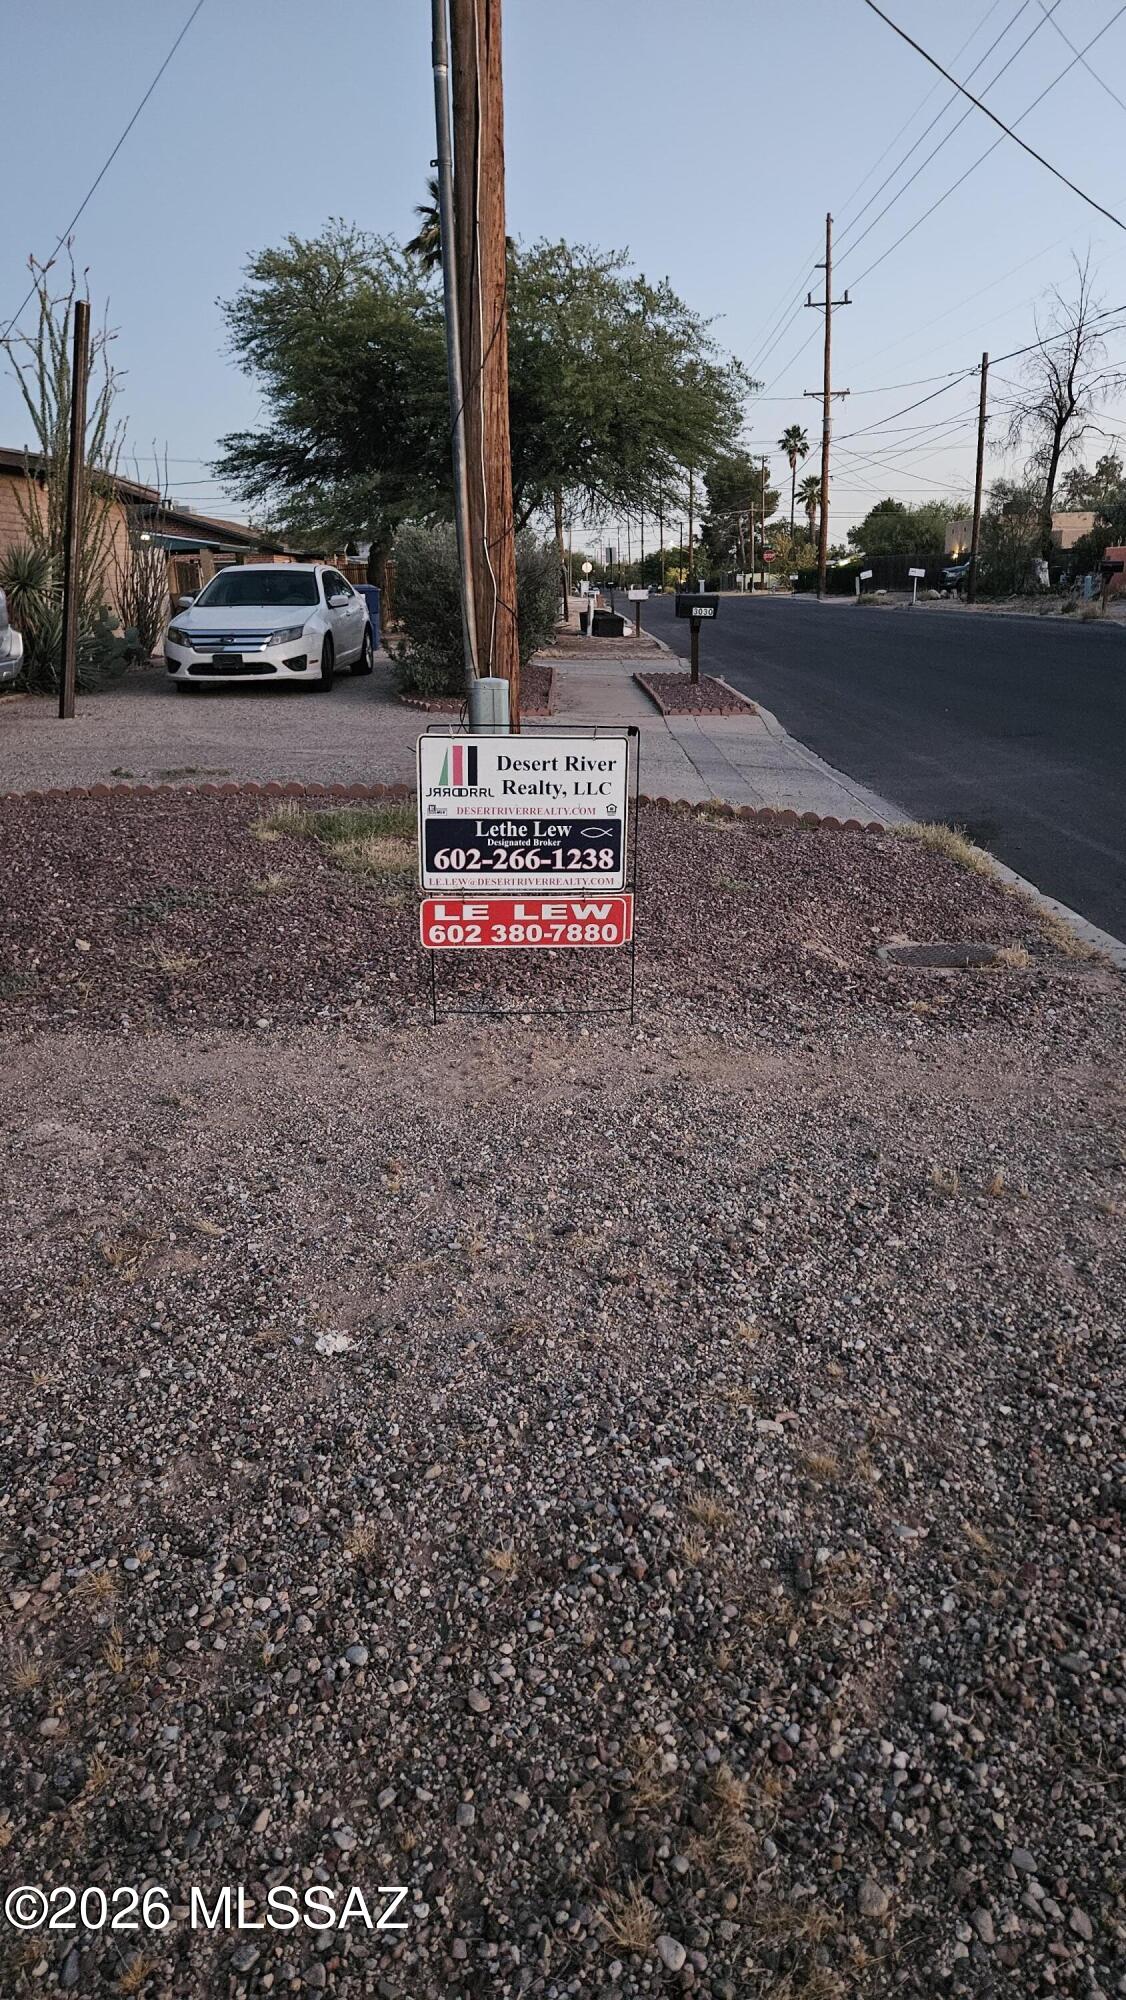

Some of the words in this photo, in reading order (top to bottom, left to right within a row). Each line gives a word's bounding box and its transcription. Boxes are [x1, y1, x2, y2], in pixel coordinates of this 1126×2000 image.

[497, 755, 558, 771] Desert
[565, 755, 617, 771] River
[502, 779, 567, 799] Realty,
[574, 781, 612, 796] LLC
[456, 806, 596, 816] DESERTRIVERREALTY.COM
[475, 821, 528, 837] Lethe
[533, 821, 573, 837] Lew
[487, 838, 531, 847] Designated
[533, 838, 561, 847] Broker
[433, 848, 614, 870] 602-266-1238
[434, 904, 490, 921] LE
[514, 904, 613, 920] LEW
[428, 925, 482, 943] 602
[490, 924, 618, 943] 380-7880
